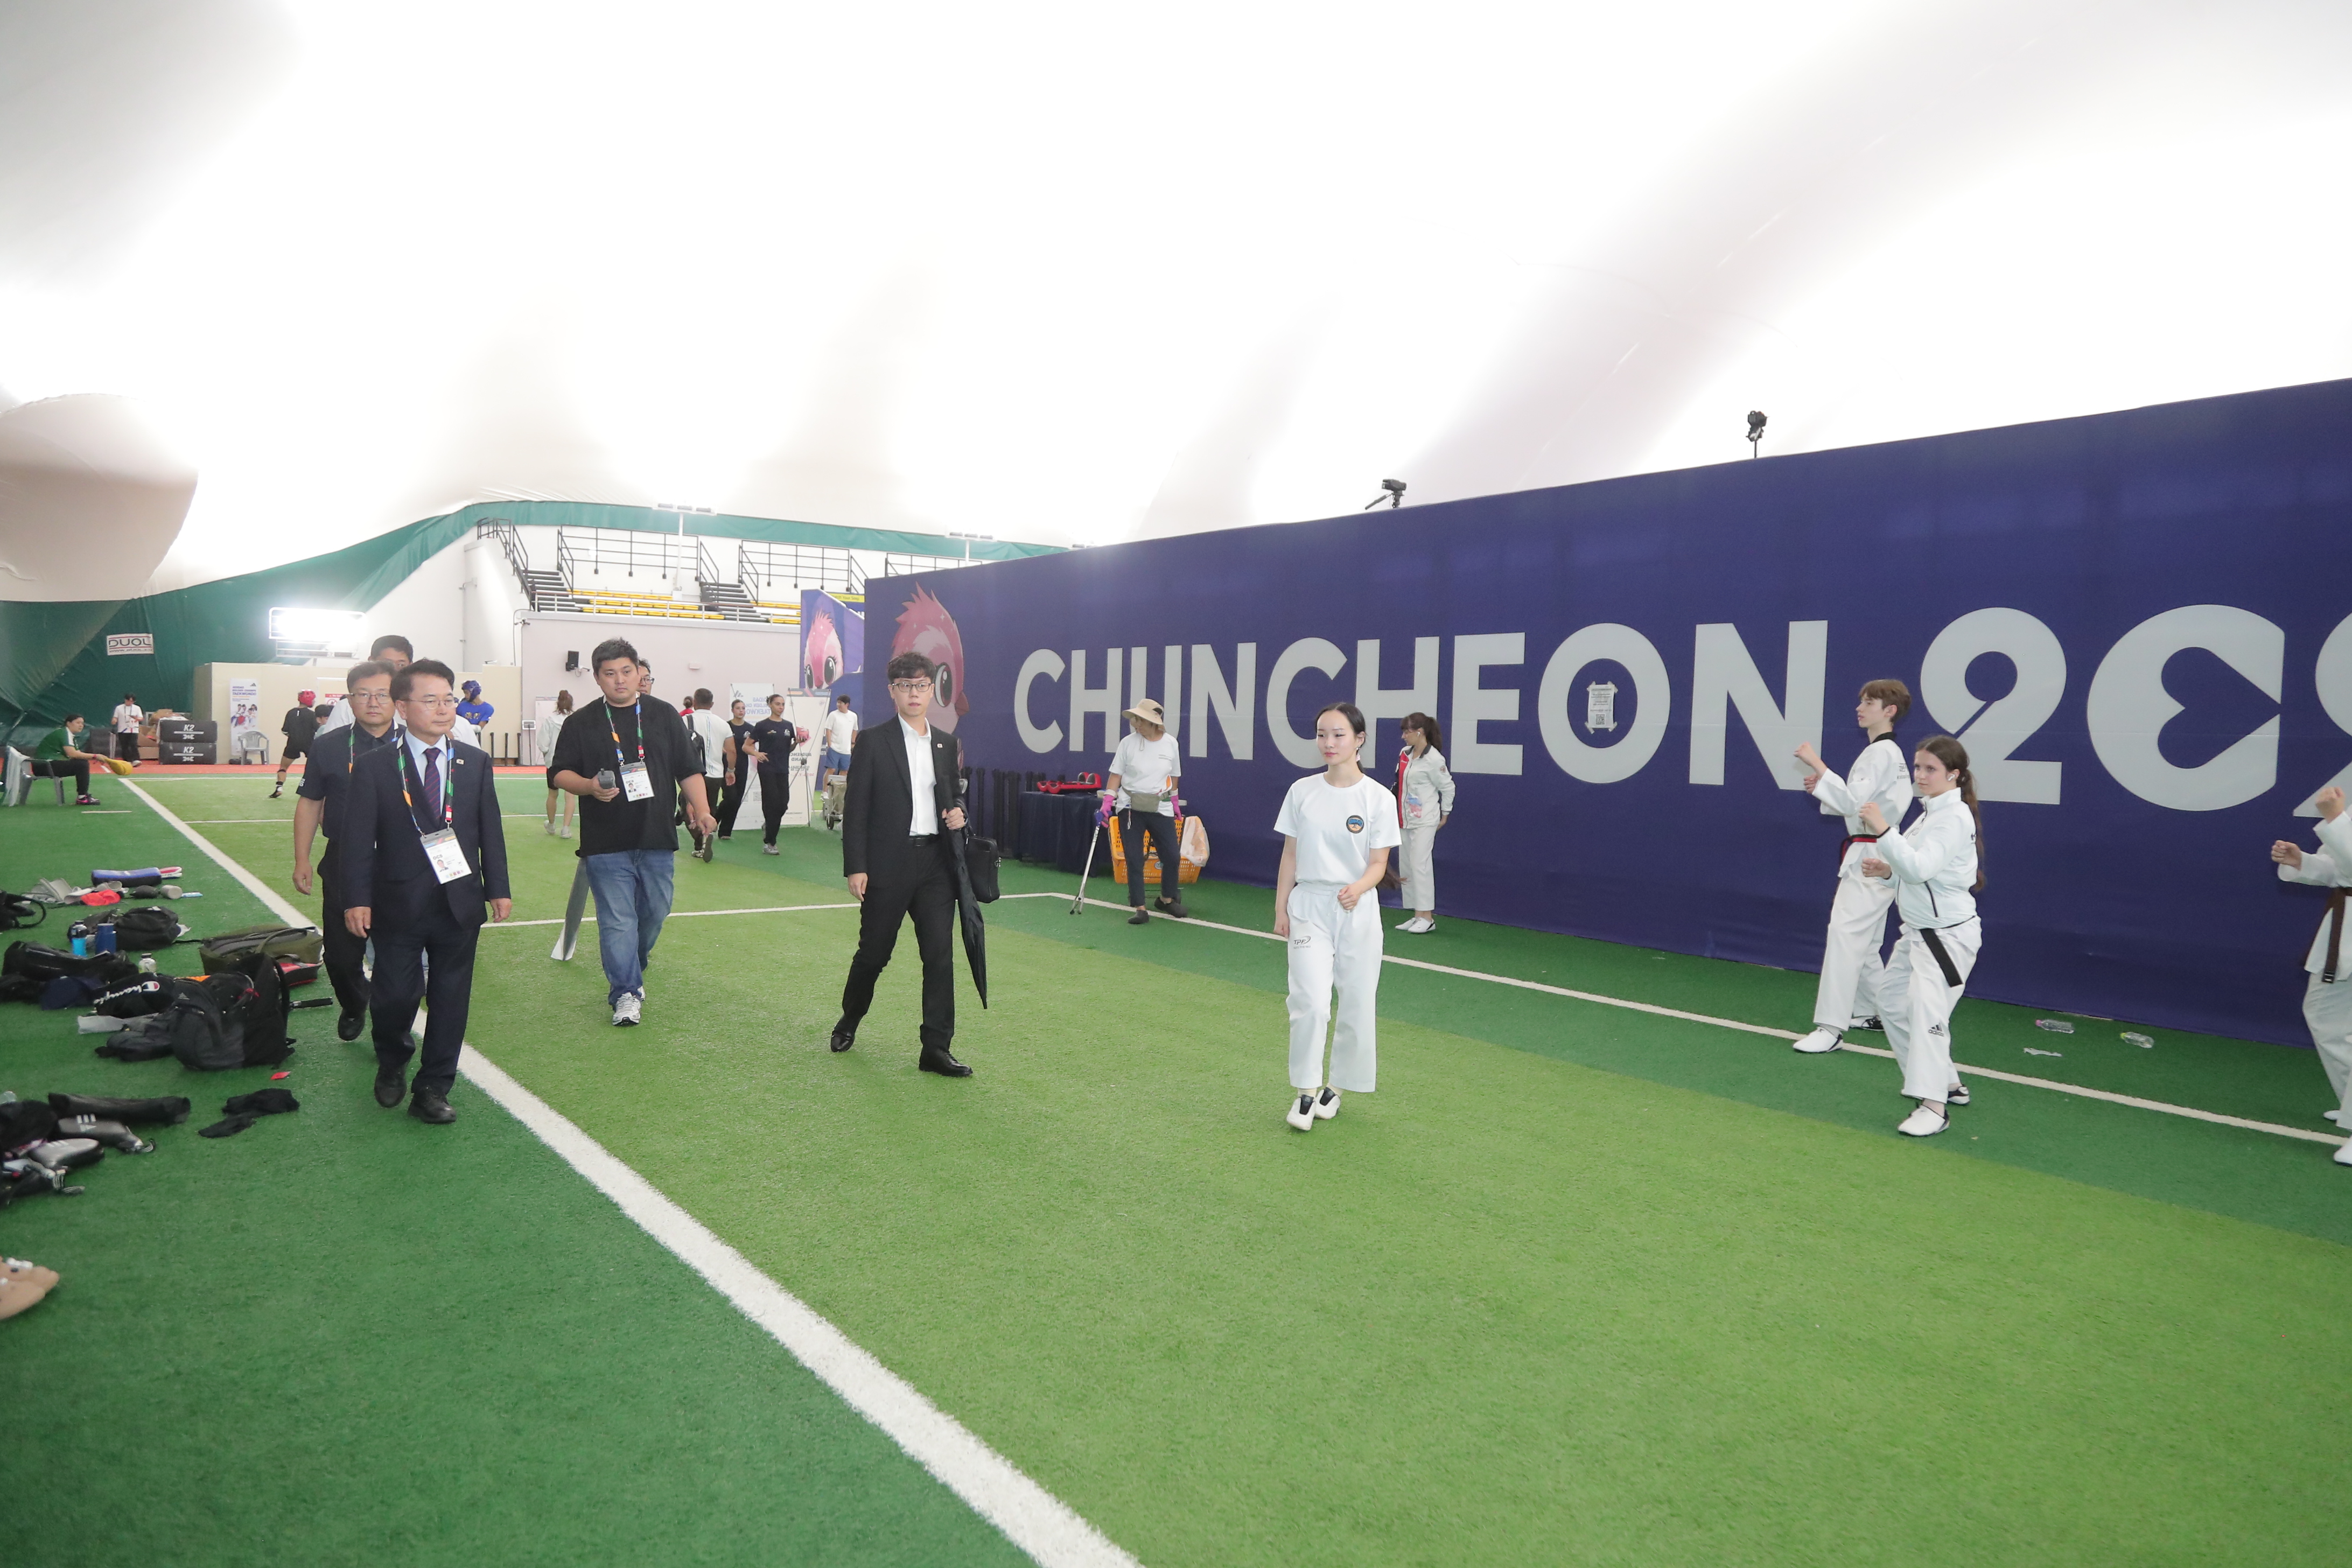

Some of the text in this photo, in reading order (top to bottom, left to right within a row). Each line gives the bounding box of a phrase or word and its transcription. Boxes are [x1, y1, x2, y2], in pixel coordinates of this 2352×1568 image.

[109, 639, 152, 647] DUOL
[1014, 620, 1828, 791] CHUNCHEON
[93, 981, 160, 1005] Champio
